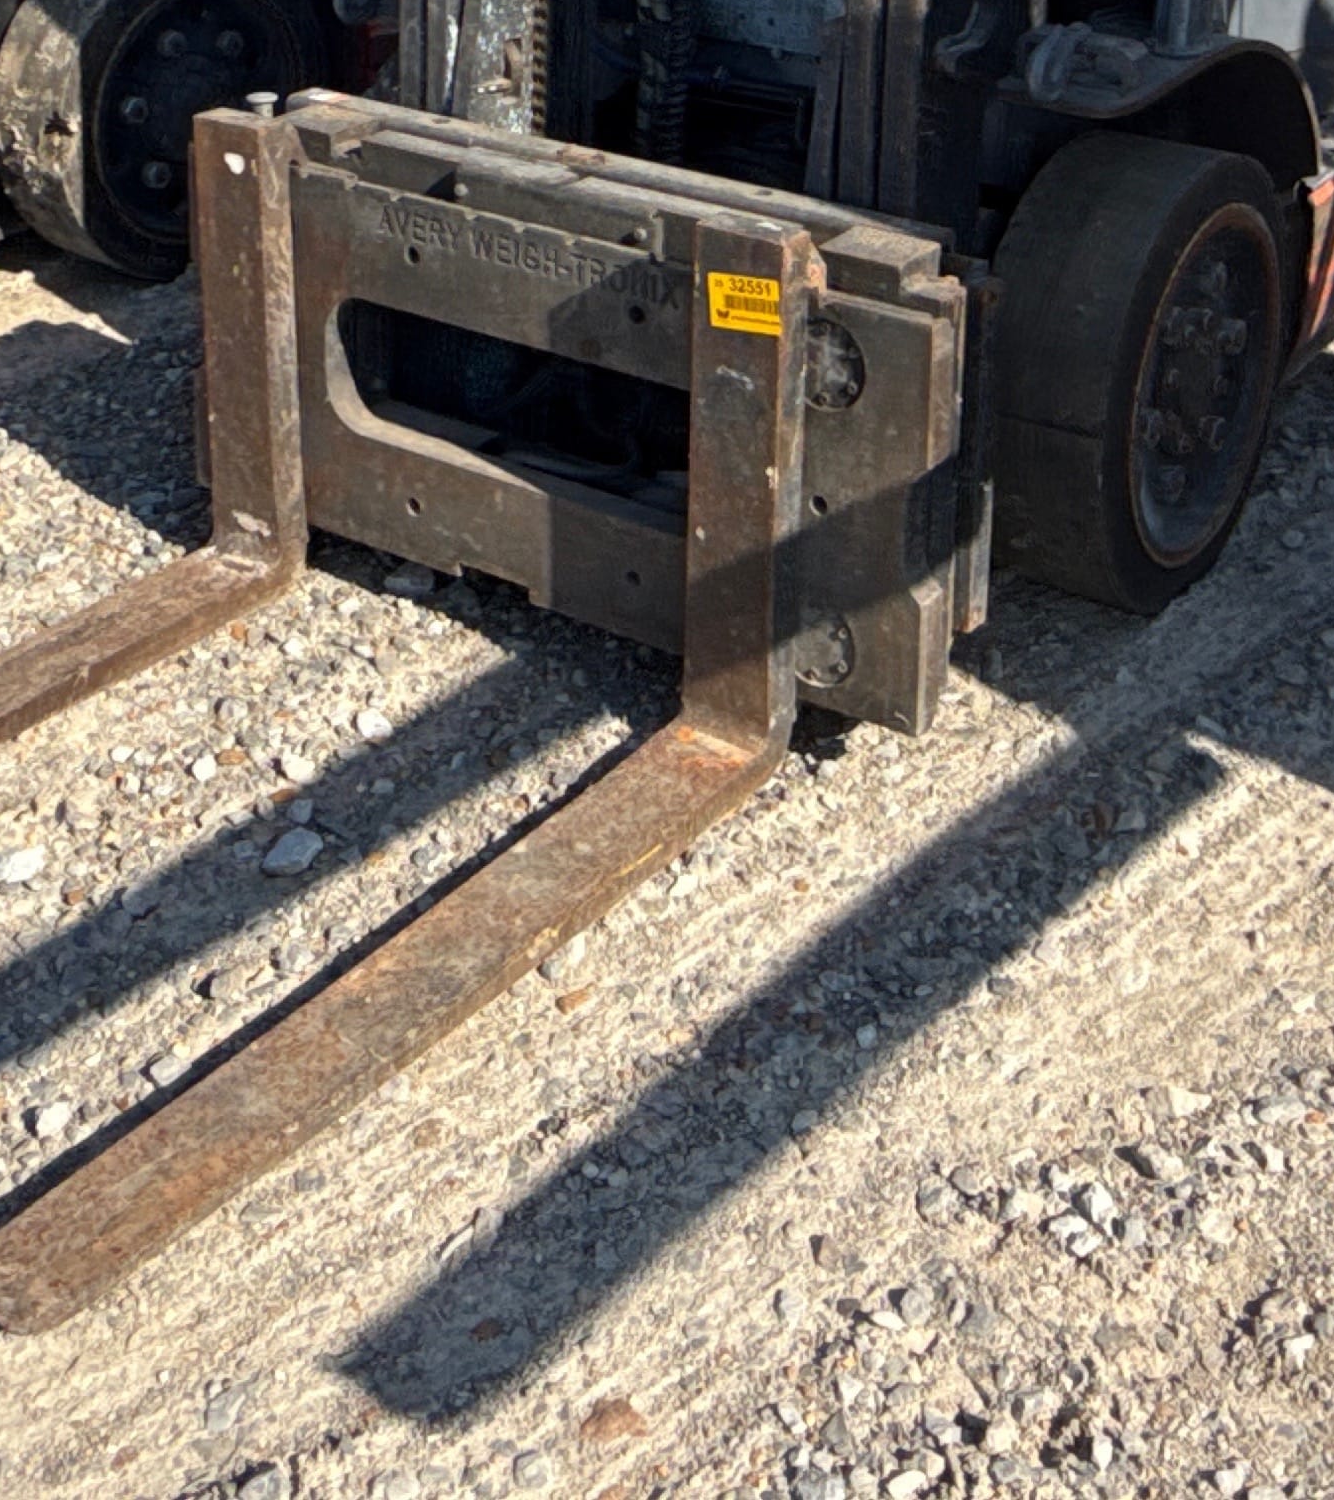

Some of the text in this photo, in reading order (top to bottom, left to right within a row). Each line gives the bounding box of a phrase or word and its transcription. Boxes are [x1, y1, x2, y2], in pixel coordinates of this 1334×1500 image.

[379, 204, 680, 310] AVERY WEIGH-TRONIX
[728, 278, 772, 297] 32551
